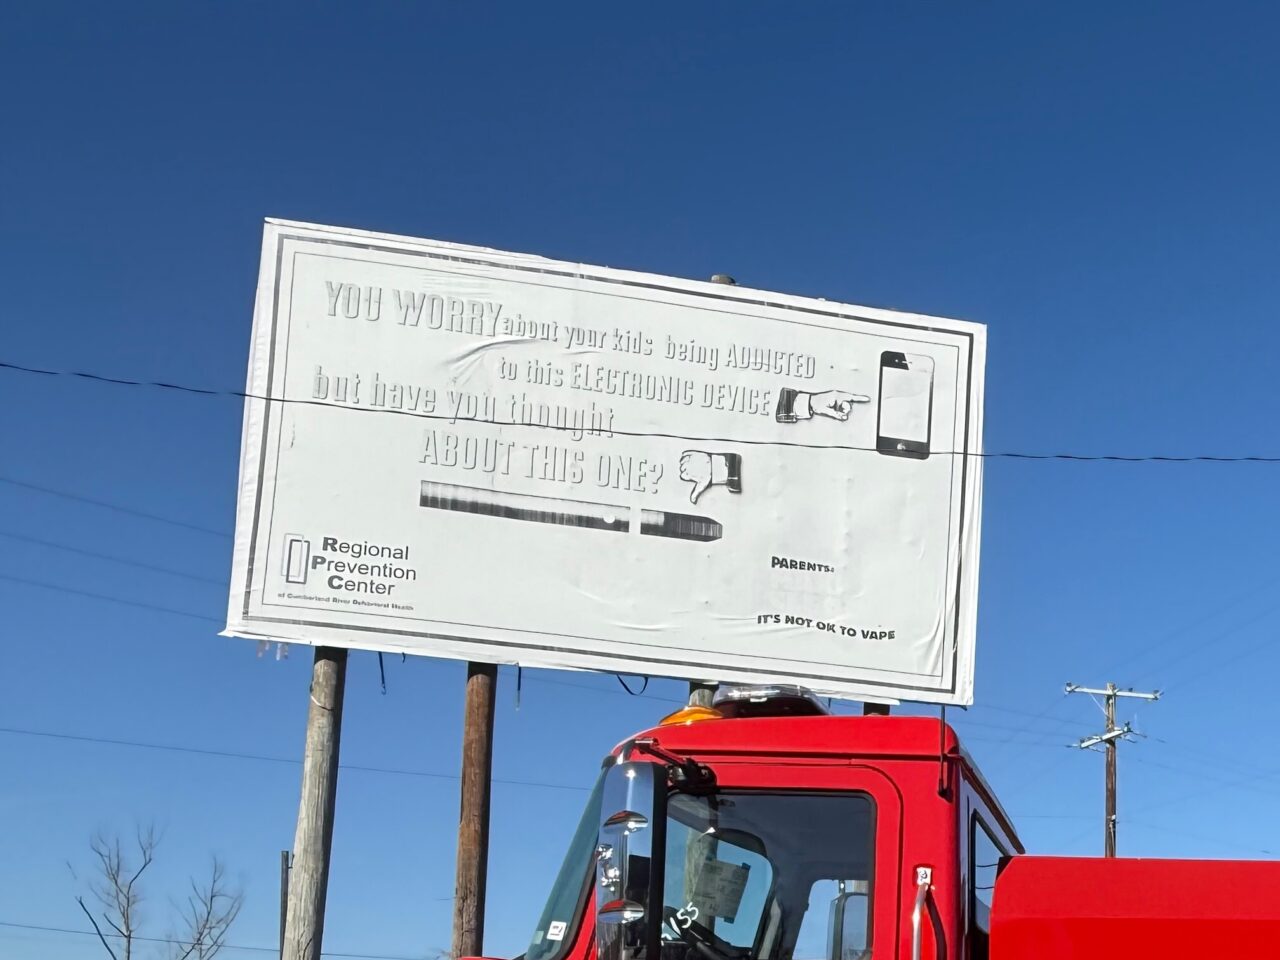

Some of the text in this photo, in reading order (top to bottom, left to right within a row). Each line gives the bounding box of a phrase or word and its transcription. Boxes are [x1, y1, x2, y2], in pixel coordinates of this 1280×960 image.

[325, 281, 816, 379] YOU WORRY about your kids being ADDICTED
[312, 365, 614, 441] but have you thought
[499, 357, 770, 417] to this ELECTRONIC DEVICE
[418, 429, 664, 495] ABOUT THIS ONE?
[311, 556, 416, 581] Prevention
[322, 537, 409, 561] Regional
[327, 575, 396, 596] Center
[757, 615, 896, 640] IT'S NOT OK TO VAPE
